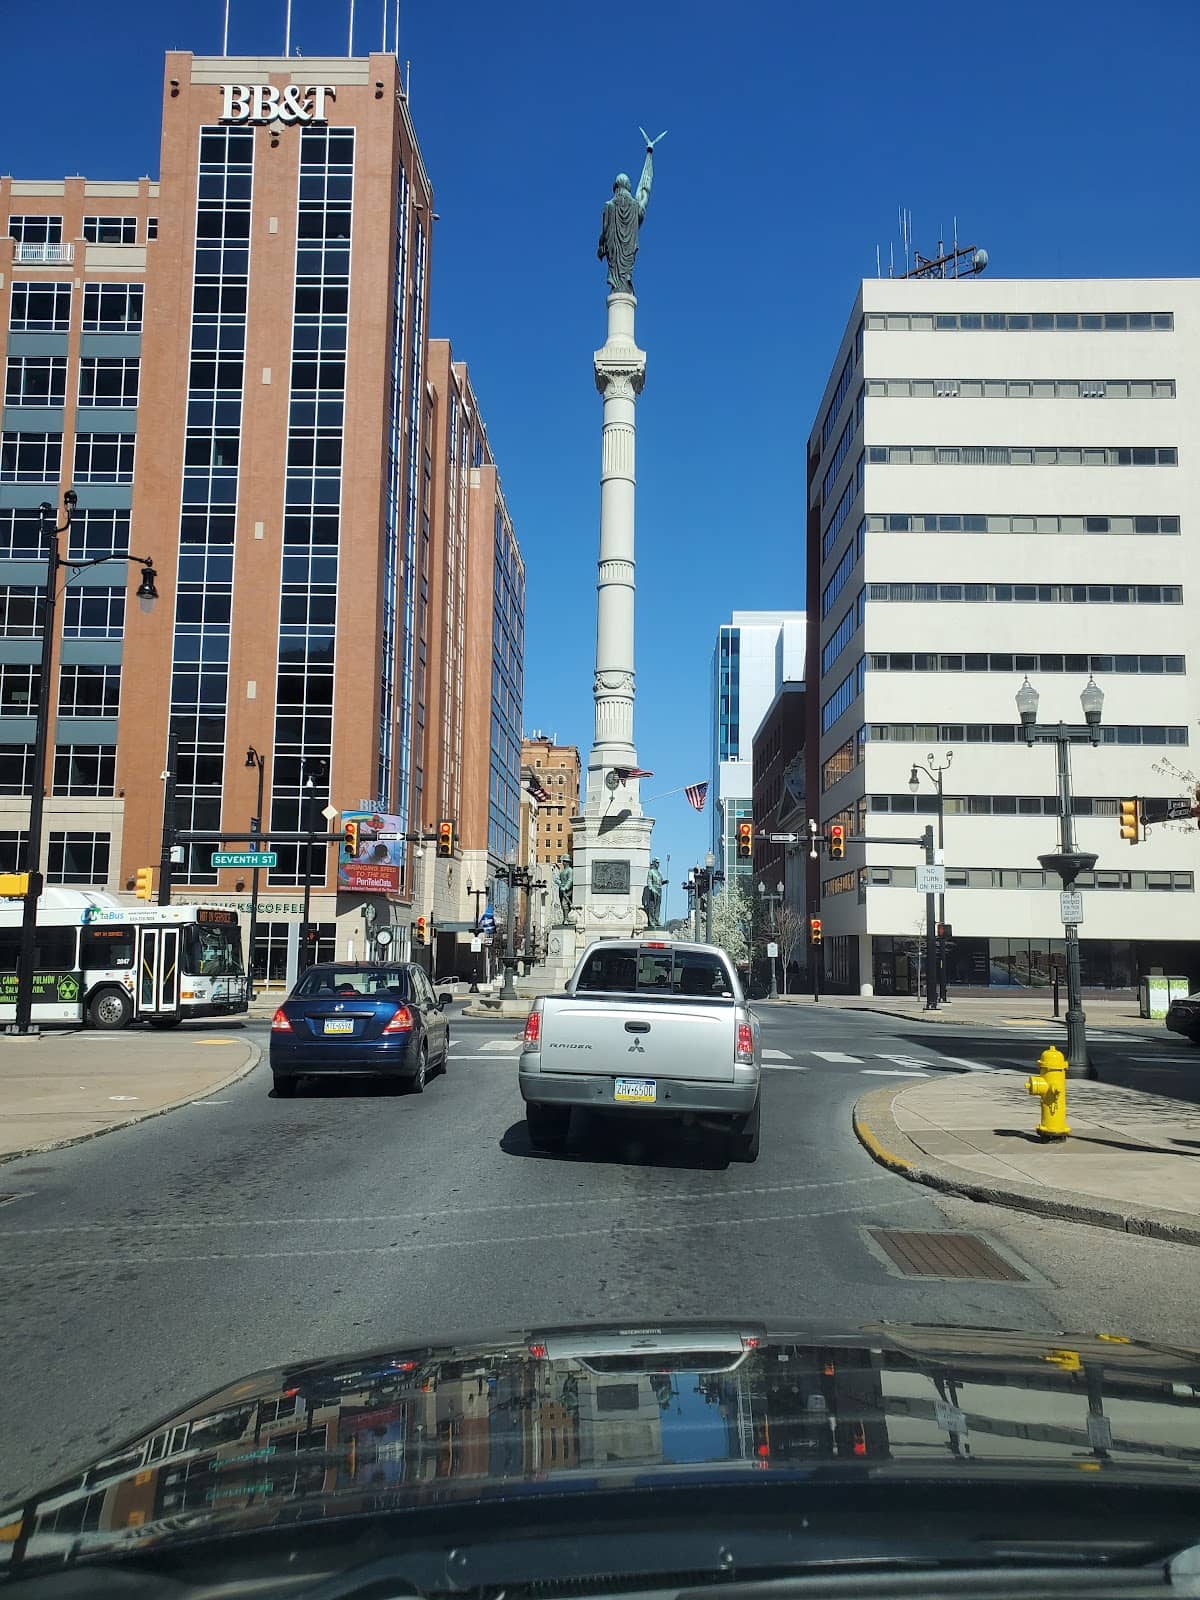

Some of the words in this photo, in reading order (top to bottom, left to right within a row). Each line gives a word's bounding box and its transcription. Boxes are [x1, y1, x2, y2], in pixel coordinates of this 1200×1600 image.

[219, 85, 336, 122] BB&T
[215, 855, 258, 864] SEVENTH
[262, 855, 274, 864] ST
[257, 903, 305, 914] COFFEE
[200, 911, 208, 921] NOT
[209, 911, 214, 922] IN
[215, 912, 231, 922] SERVICE
